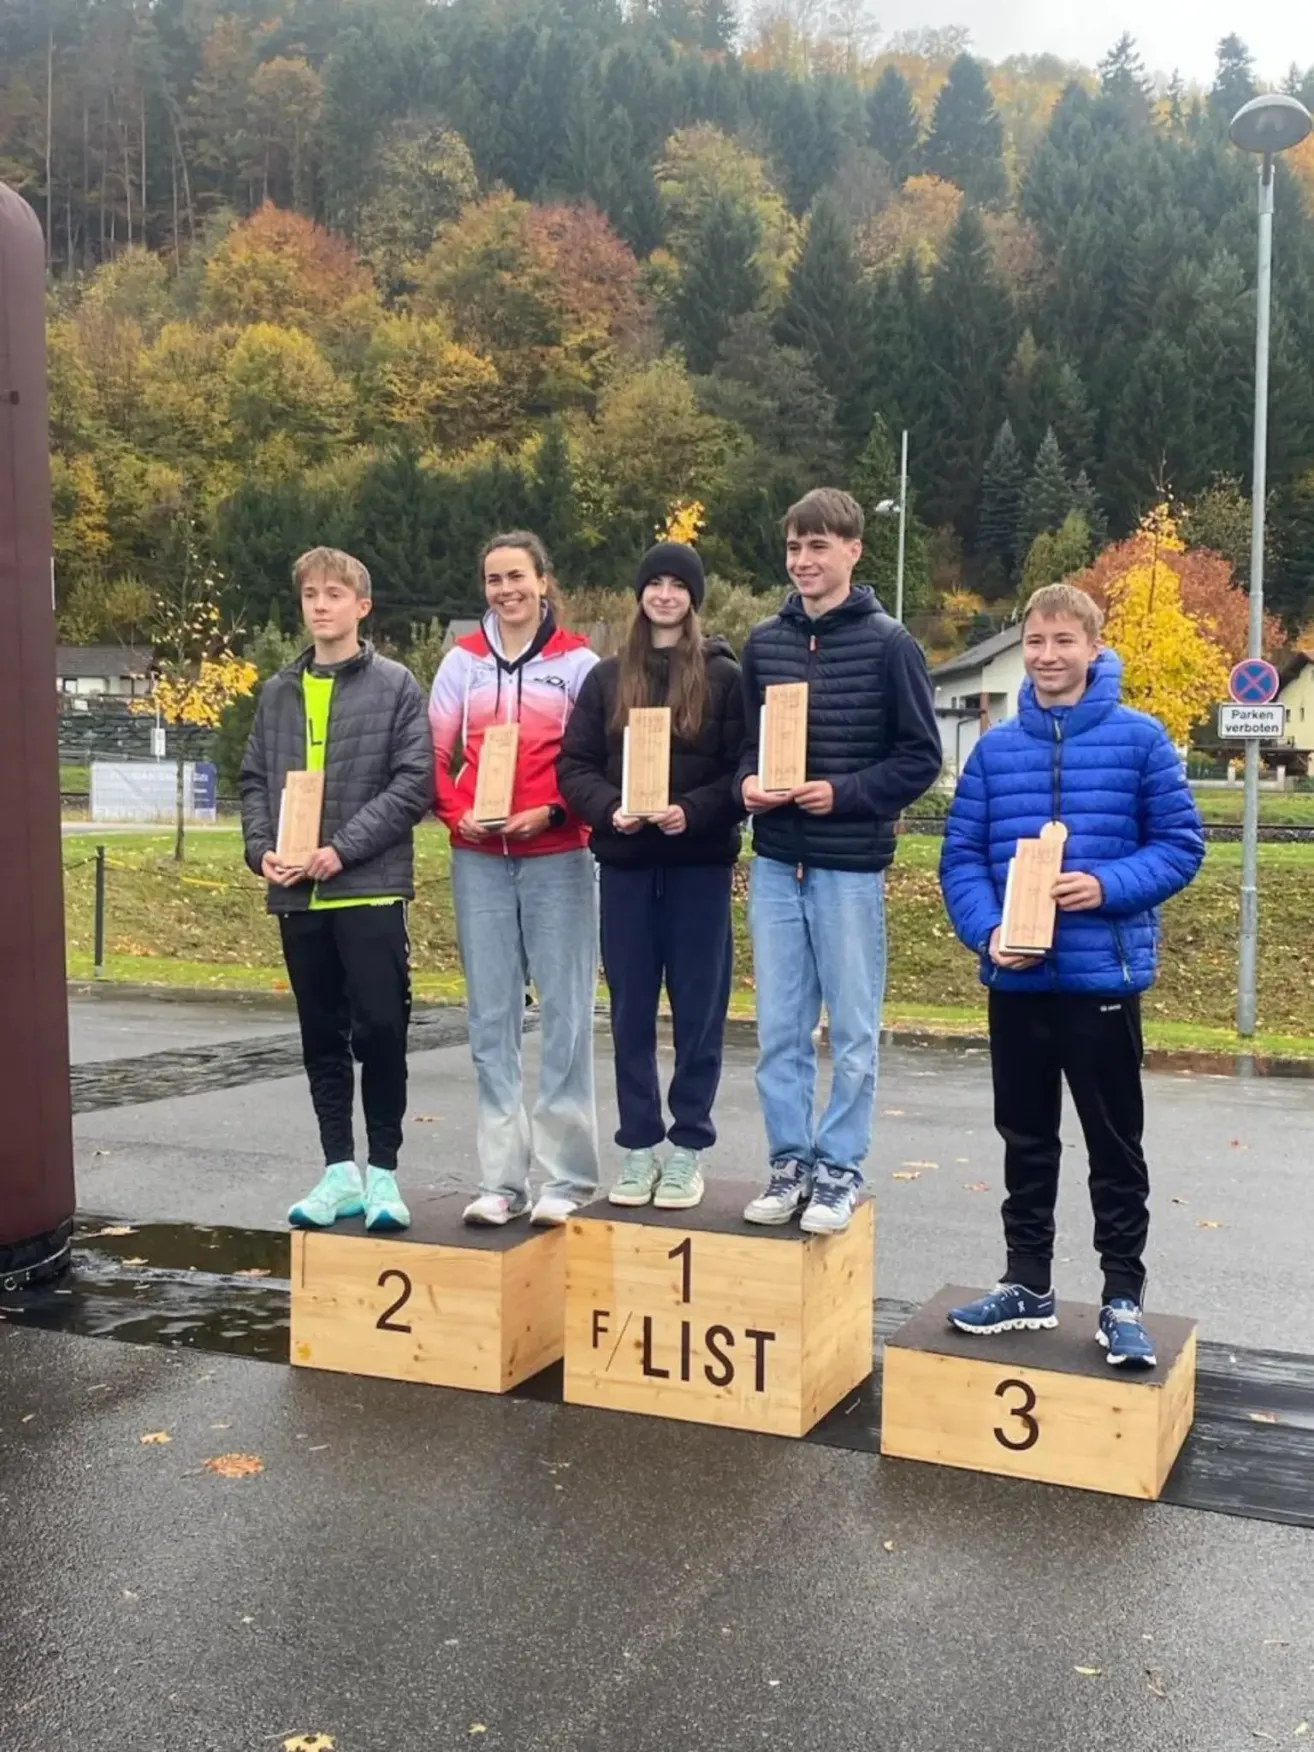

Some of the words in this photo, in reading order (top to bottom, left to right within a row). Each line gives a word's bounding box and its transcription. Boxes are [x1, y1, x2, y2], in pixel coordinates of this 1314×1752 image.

[1225, 723, 1279, 733] verboten
[1231, 709, 1274, 719] Parken
[376, 1269, 412, 1334] 2
[668, 1237, 692, 1304] 1
[993, 1379, 1040, 1451] 3
